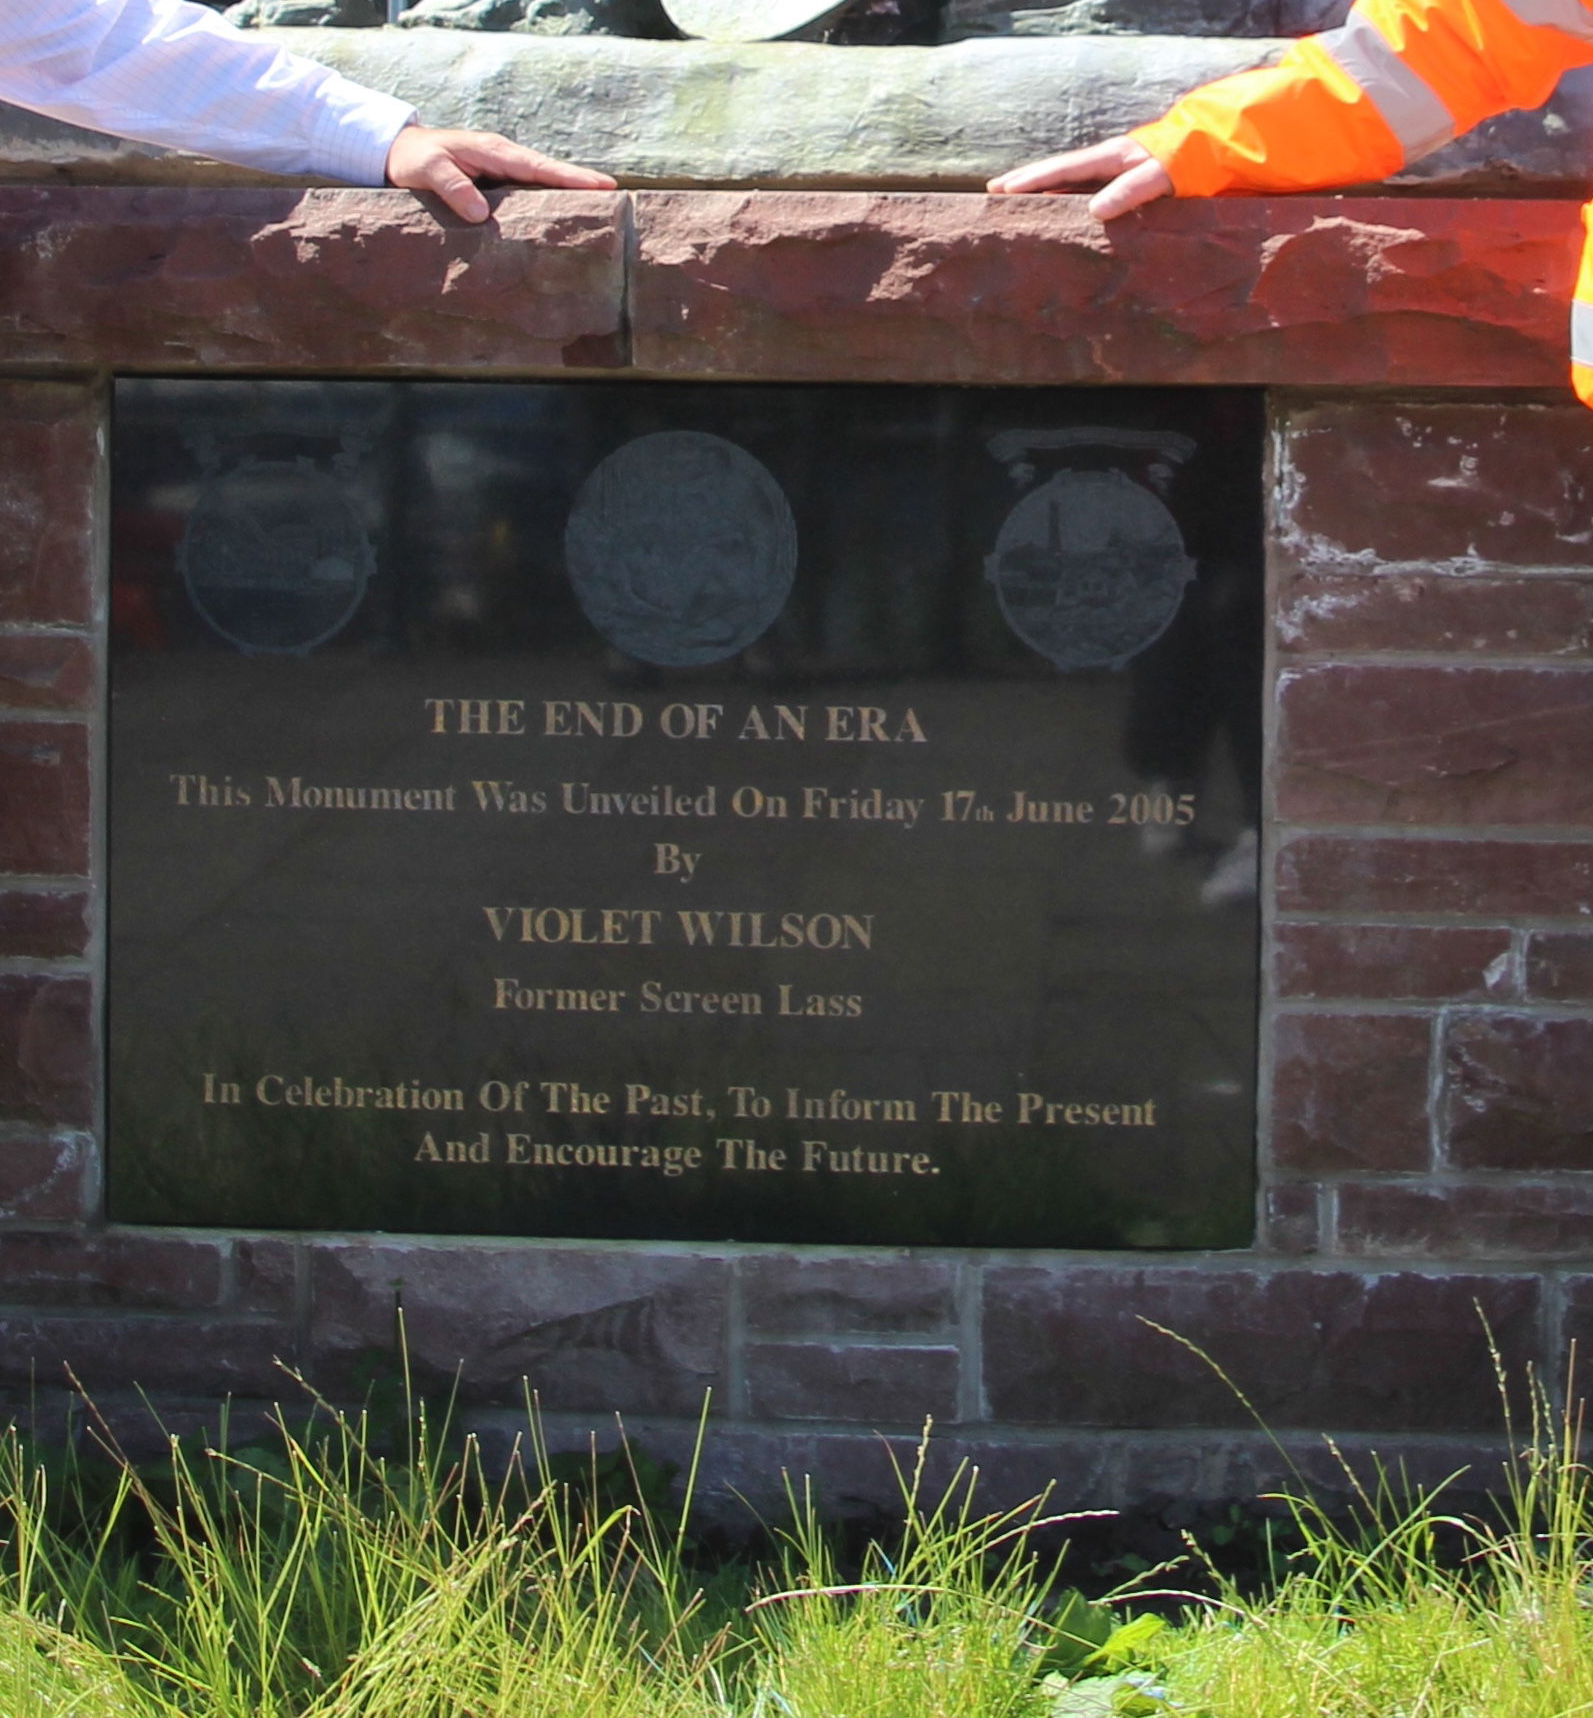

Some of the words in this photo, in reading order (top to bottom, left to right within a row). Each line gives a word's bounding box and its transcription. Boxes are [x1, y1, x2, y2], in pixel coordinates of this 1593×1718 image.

[425, 699, 525, 734] THE
[543, 701, 643, 737] END
[660, 703, 723, 739] OF
[739, 705, 806, 741] AN
[825, 706, 928, 743] ERA
[170, 774, 250, 807] This
[265, 776, 455, 811] Monument
[471, 780, 547, 814] Was
[562, 782, 717, 817] Unveiled
[732, 786, 787, 819] On
[802, 787, 924, 829] Friday
[940, 790, 994, 823] 17th
[1006, 791, 1093, 824] June
[1107, 793, 1196, 826] 2005
[654, 843, 702, 883] By
[483, 906, 661, 945] VIOLET
[677, 910, 875, 950] WILSON
[494, 977, 626, 1012] Former
[640, 981, 762, 1015] Screen
[778, 984, 862, 1017] Lass
[204, 1073, 241, 1105] In
[256, 1074, 464, 1112] Celebration
[478, 1080, 530, 1113] Of
[540, 1082, 610, 1115] The
[625, 1083, 716, 1121] Past,
[728, 1086, 771, 1119] To
[786, 1088, 917, 1122] Inform
[932, 1091, 1003, 1124] The
[1017, 1092, 1157, 1126] Present
[414, 1131, 490, 1164] And
[506, 1133, 702, 1177] Encourage
[717, 1139, 787, 1171] The
[802, 1141, 940, 1175] Future.
